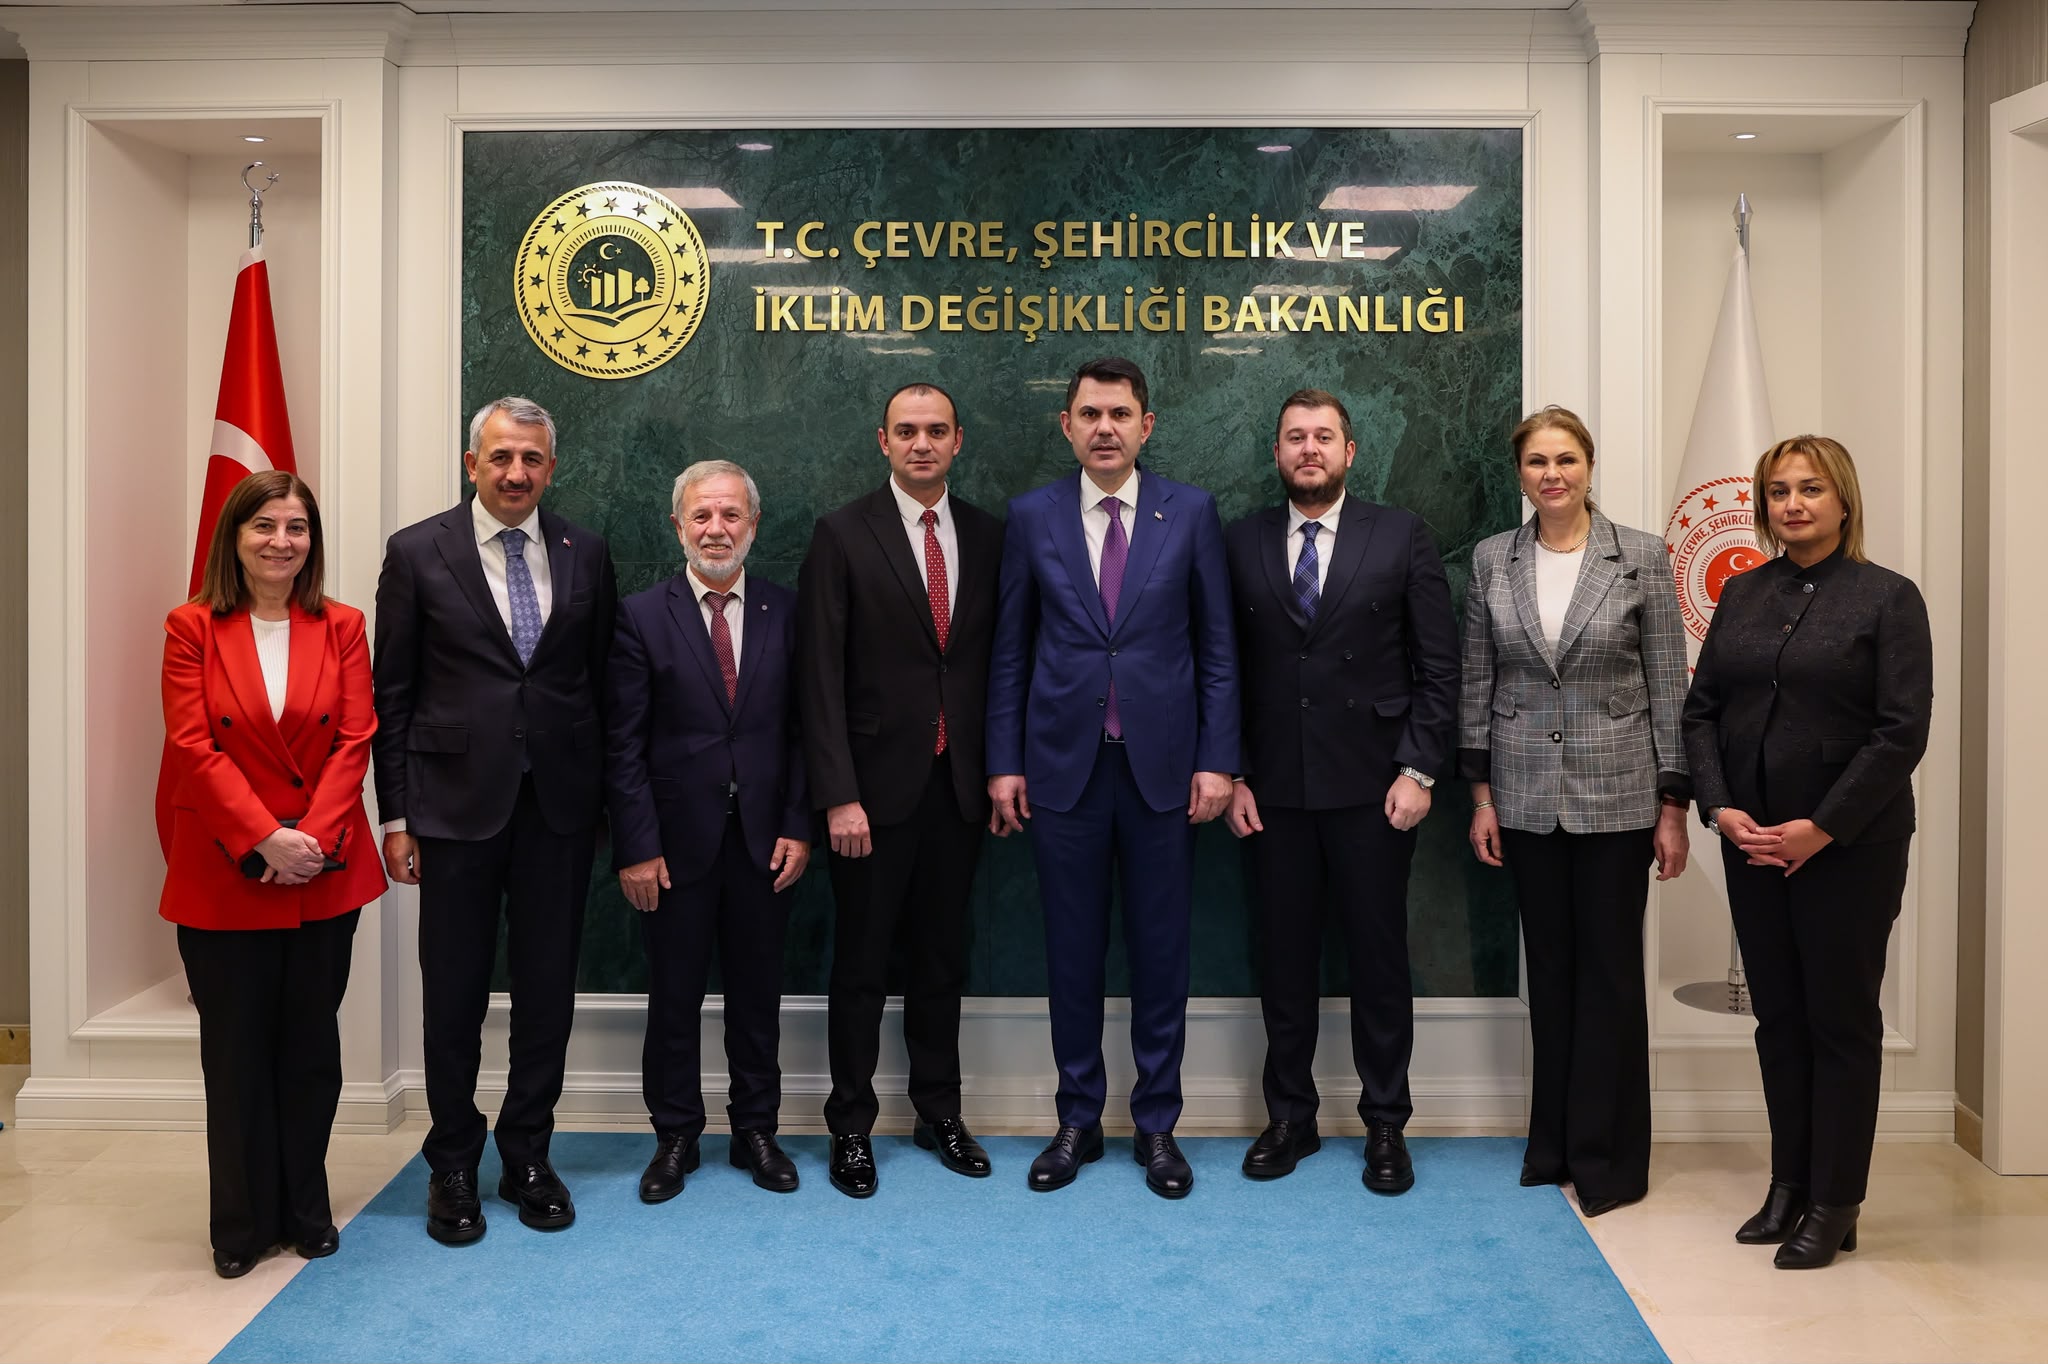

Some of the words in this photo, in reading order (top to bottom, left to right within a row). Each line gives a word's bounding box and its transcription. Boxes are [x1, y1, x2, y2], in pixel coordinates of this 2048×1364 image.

[756, 220, 840, 259] T.C.
[853, 220, 1018, 269] ÇEVRE,
[1033, 212, 1295, 269] ŞEHİRCİLİK
[1306, 222, 1365, 258] VE
[755, 286, 886, 332] İKLİM
[901, 286, 1187, 343] DEĞİŞİKLİĞİ
[1203, 287, 1465, 334] BAKANLIĞI
[1683, 527, 1711, 556] ÇEVRE,
[1708, 512, 1754, 534] ŞEHİRCİL
